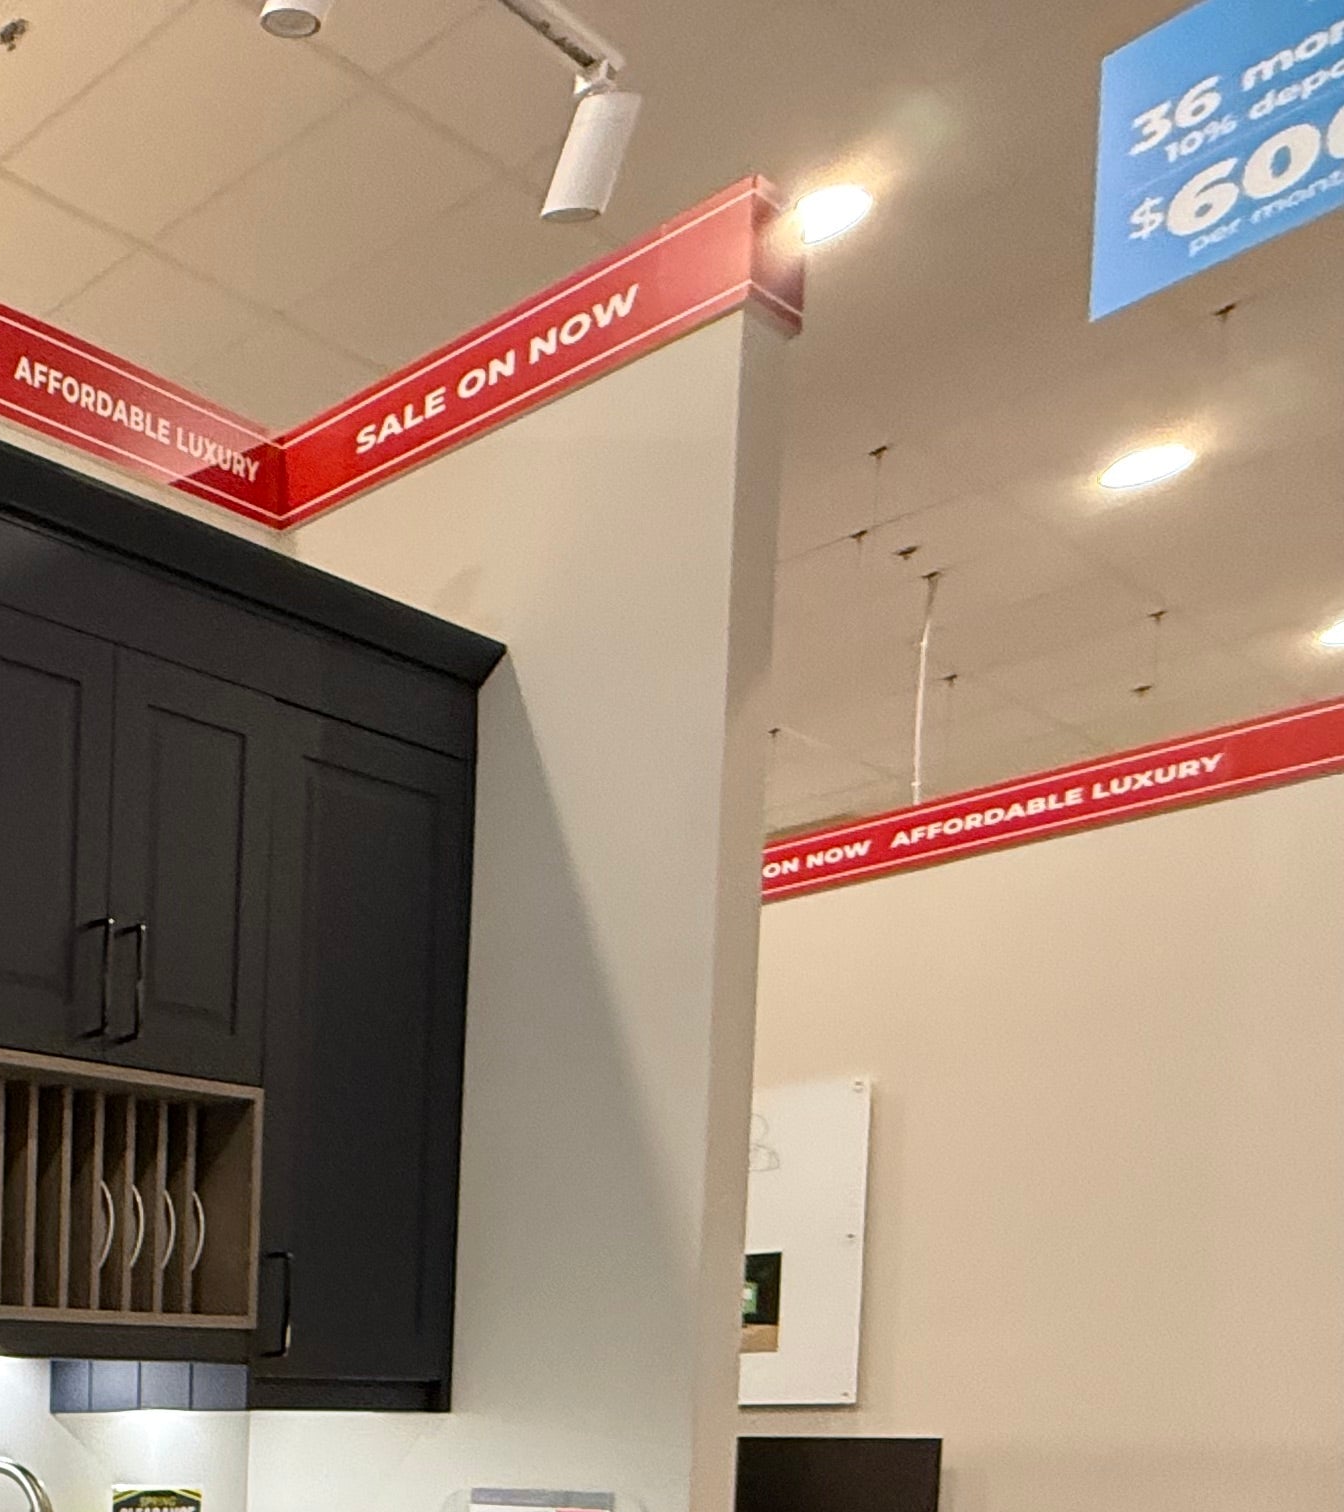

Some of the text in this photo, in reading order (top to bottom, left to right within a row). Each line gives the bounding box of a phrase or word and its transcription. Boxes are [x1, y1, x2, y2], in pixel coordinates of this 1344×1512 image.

[1128, 75, 1222, 156] 36
[1128, 104, 1344, 239] $60
[14, 355, 171, 445] AFFORDABLE
[176, 427, 260, 482] LUXURY
[356, 283, 639, 454] SALE ON NOW
[762, 752, 1224, 878] ON NOW AFFORDABLE LUXURY
